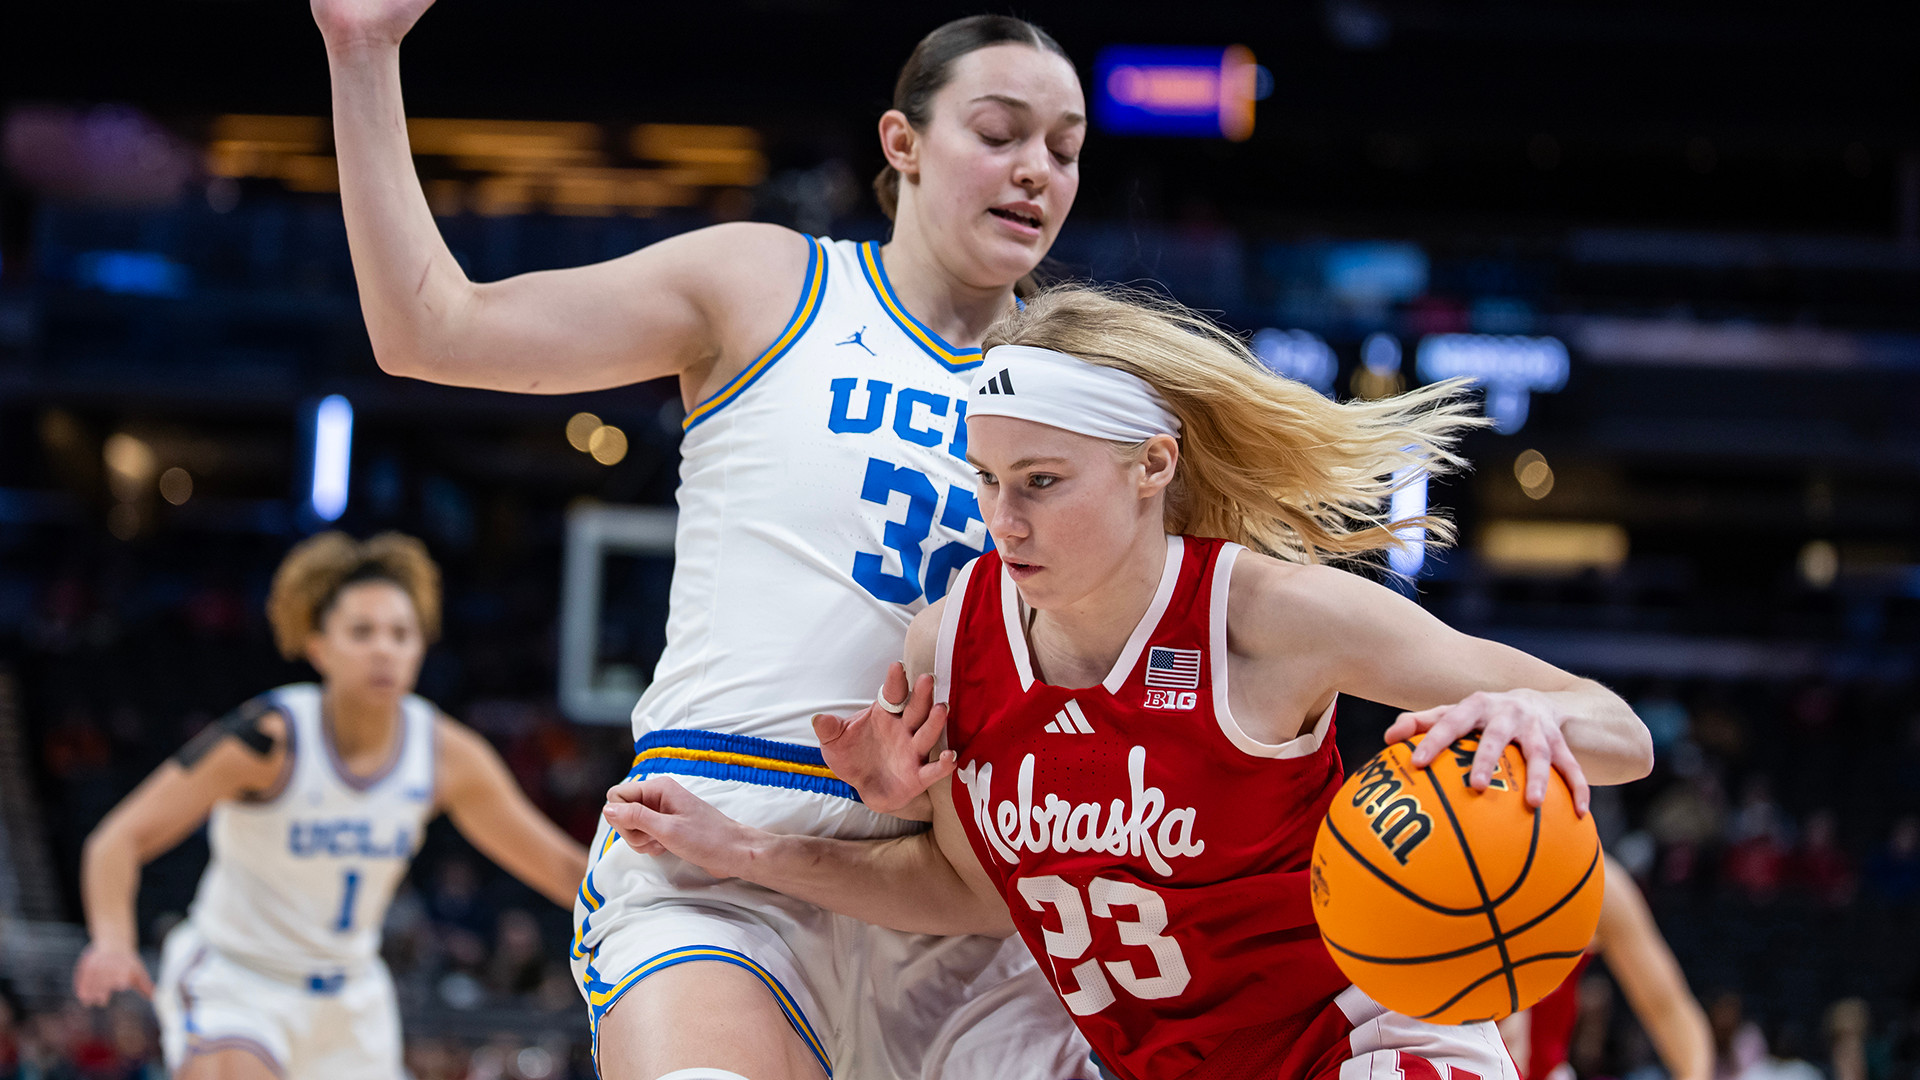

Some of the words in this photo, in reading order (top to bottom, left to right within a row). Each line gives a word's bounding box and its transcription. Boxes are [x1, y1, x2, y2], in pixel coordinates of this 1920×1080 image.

[957, 745, 1205, 877] Nebraska
[1352, 754, 1434, 867] Wilso
[336, 870, 359, 932] 1
[1016, 875, 1192, 1017] 23
